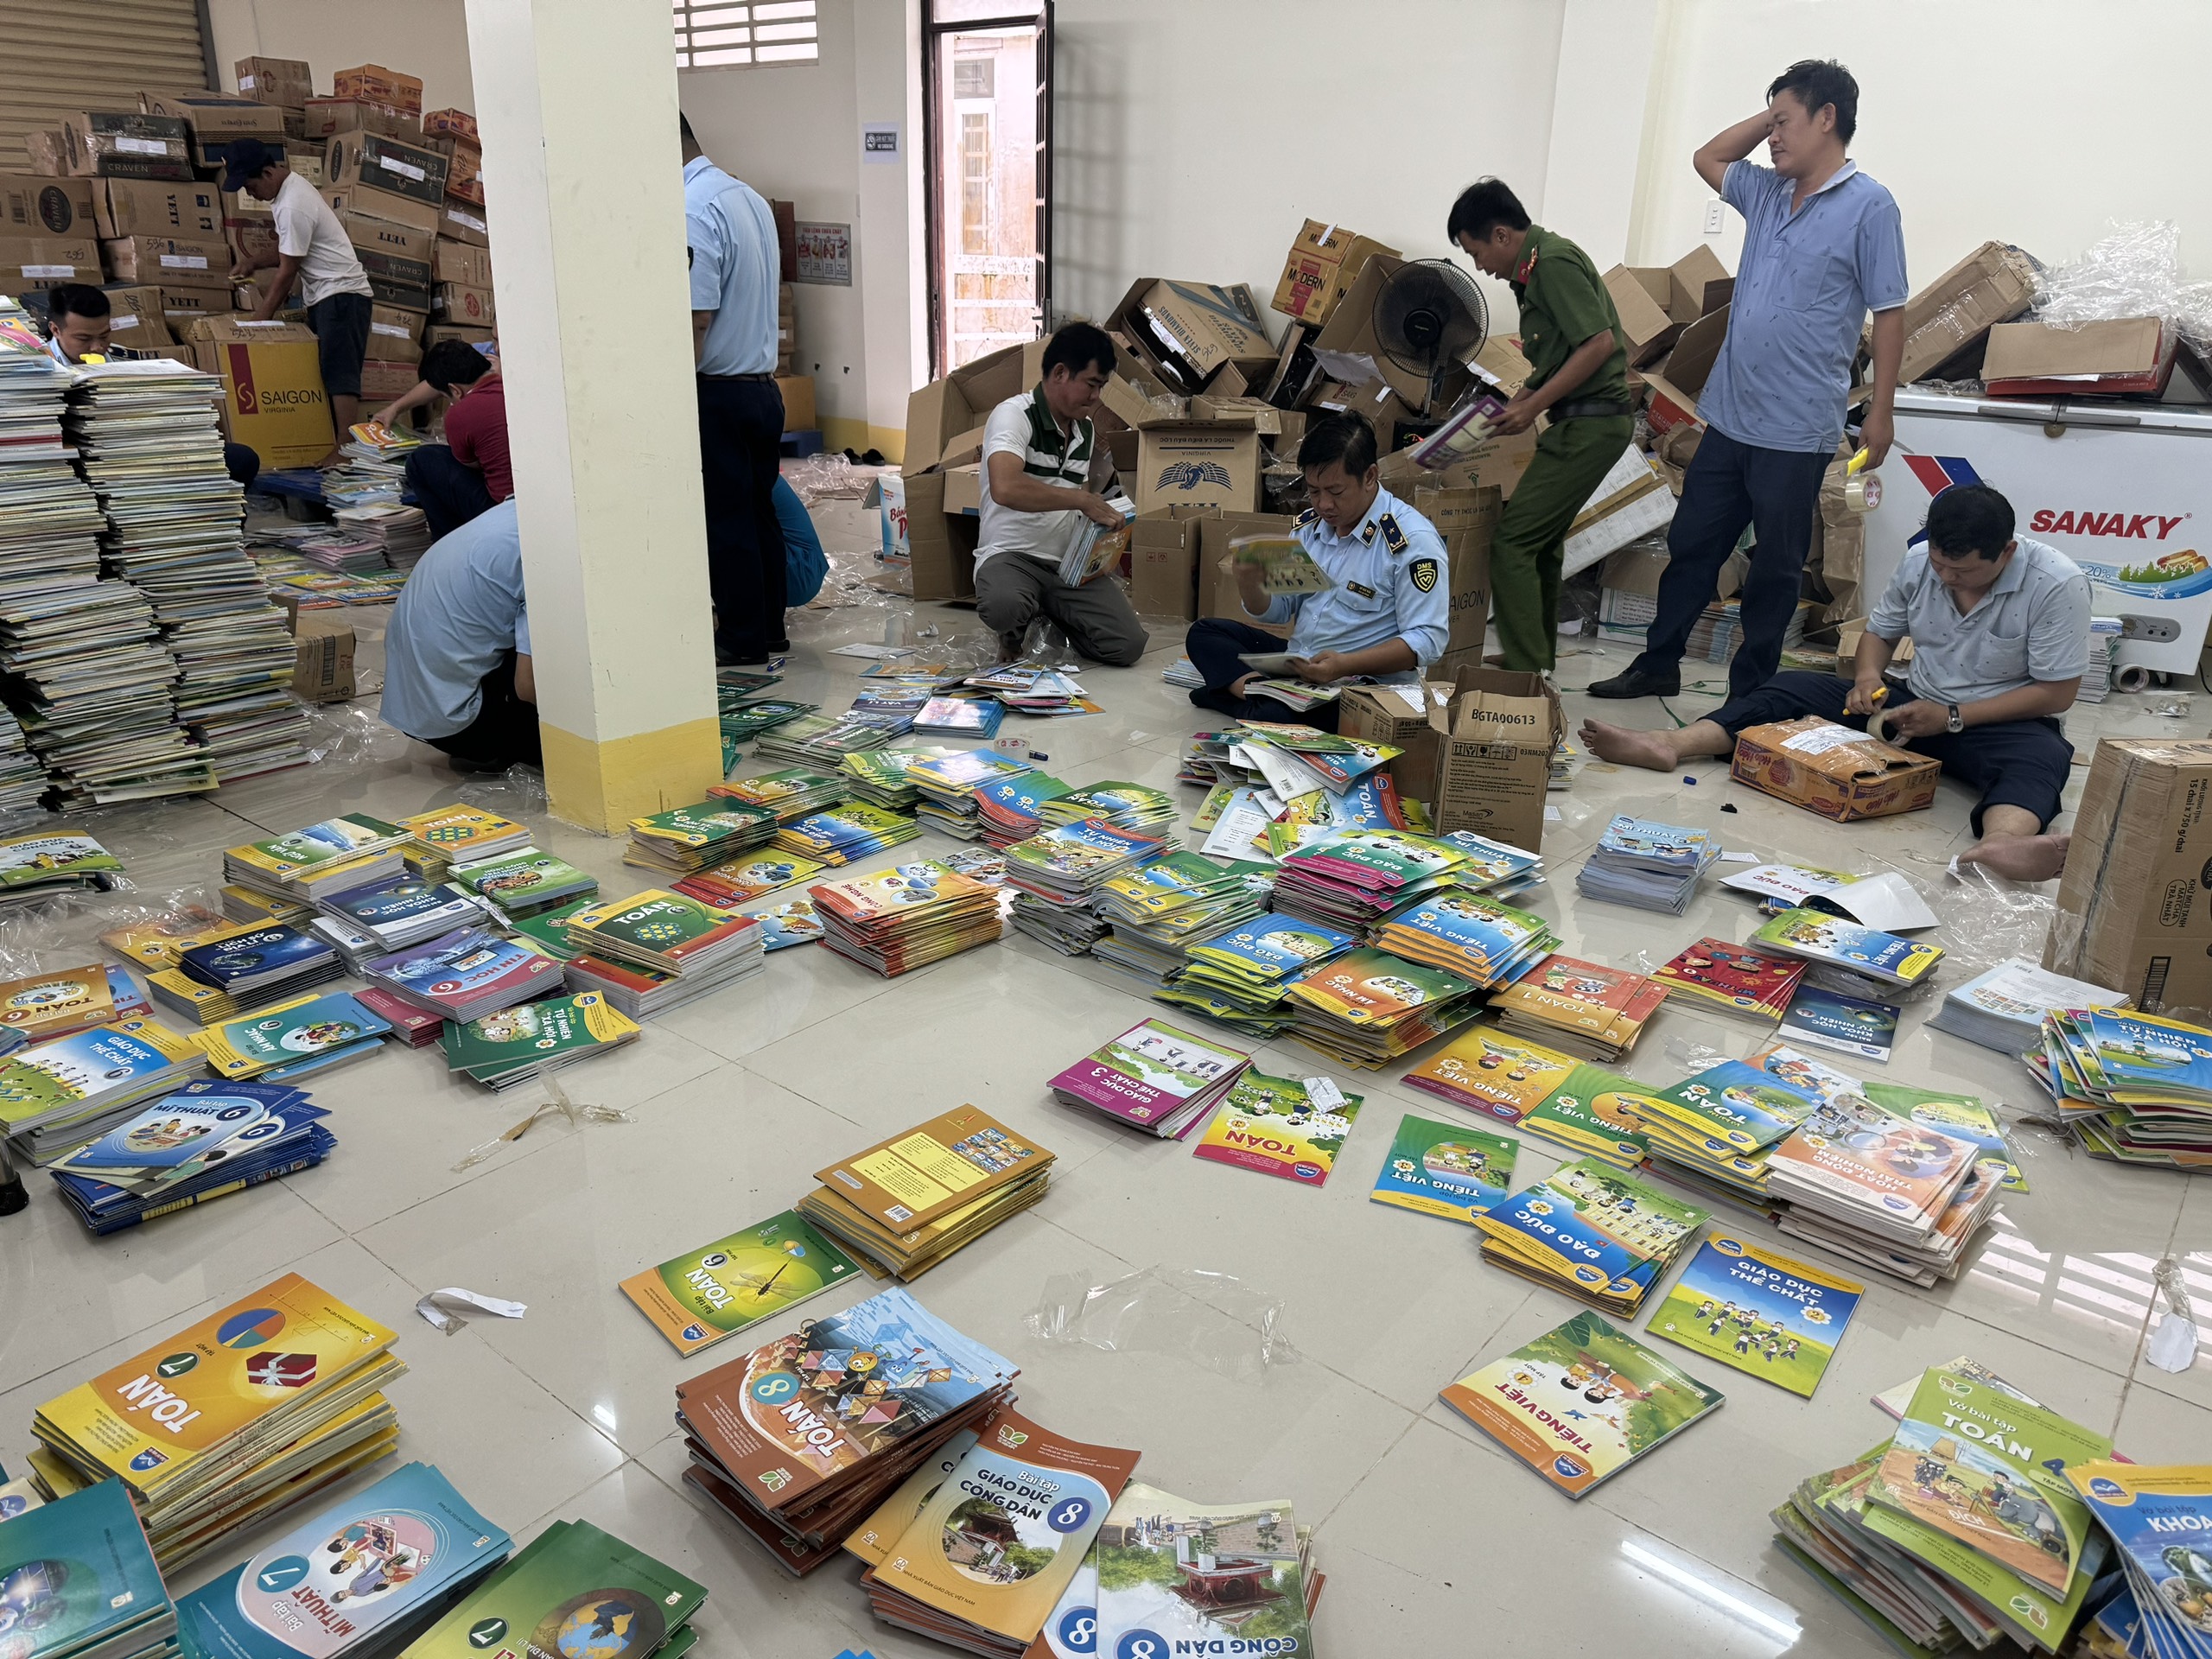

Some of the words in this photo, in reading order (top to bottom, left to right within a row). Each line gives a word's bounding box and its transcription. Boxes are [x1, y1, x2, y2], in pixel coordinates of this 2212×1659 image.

[108, 163, 149, 173] CRAVEN
[404, 155, 438, 171] CRAVEN
[48, 190, 60, 230] CRAVEN
[1308, 233, 1338, 249] MOERN
[391, 263, 423, 275] CRAVEN
[1287, 268, 1325, 291] MODERN
[1158, 306, 1185, 340] DIAMONDS
[1184, 334, 1201, 354] SEVEN
[261, 390, 321, 405] SAIGON
[2030, 509, 2184, 540] SANAKY
[1449, 589, 1484, 613] AIGON
[1471, 709, 1535, 725] BGTA00613
[2190, 779, 2198, 789] 15
[1357, 783, 1378, 819] TOÁN
[2186, 790, 2196, 807] chai
[424, 814, 470, 829] TOÁN
[2181, 814, 2190, 828] 750
[1099, 830, 1134, 847] NHIÊN
[2175, 829, 2186, 853] g/chai
[1341, 850, 1372, 862] ĐỨC
[1474, 845, 1514, 861] THUẬT
[1373, 859, 1402, 871] ĐẠO
[2167, 885, 2176, 899] TRÀ
[2187, 879, 2196, 894] KHỬ
[2162, 900, 2171, 921] NHẬT
[2171, 887, 2184, 918] MATCHA
[613, 900, 673, 925] TOÁN
[2178, 908, 2190, 928] TANH
[1410, 917, 1445, 939] VIỆT
[1225, 938, 1255, 951] ĐỨC
[1446, 931, 1490, 950] TIẾNG
[505, 952, 528, 967] TIN
[1254, 948, 1286, 962] ĐẠO
[464, 966, 502, 984] HỌC
[1324, 979, 1357, 999] NHẠC
[1356, 992, 1377, 1005] ÂM
[35, 996, 95, 1014] TOÁN
[1536, 995, 1586, 1014] TOÁN
[544, 1026, 558, 1039] HỘI
[556, 1017, 572, 1040] NHIÊN
[2119, 1022, 2139, 1034] TỰ
[2140, 1027, 2197, 1046] NHIÊN
[107, 1035, 131, 1052] GIÁO
[130, 1044, 153, 1060] DỤC
[2157, 1035, 2188, 1049] HỘI
[88, 1041, 107, 1057] THỂ
[105, 1049, 133, 1067] CHẤT
[1100, 1078, 1127, 1096] DỤC
[1432, 1067, 1471, 1090] VIỆT
[1127, 1090, 1154, 1104] GIÁO
[1135, 1086, 1161, 1099] THỂ
[1472, 1082, 1522, 1106] TIẾNG
[153, 1102, 175, 1114] MĨ
[173, 1104, 219, 1116] THUẬT
[1552, 1104, 1586, 1121] VIỆT
[1678, 1090, 1748, 1125] TOÁN
[1591, 1116, 1633, 1135] TIẾNG
[1224, 1130, 1297, 1157] TOÁN
[1391, 1171, 1427, 1187] VIỆT
[1432, 1179, 1480, 1198] TIẾNG
[1514, 1210, 1558, 1235] ĐỨC
[1557, 1234, 1603, 1260] ĐẠO
[684, 1268, 736, 1310] TOÁN
[1729, 1268, 1766, 1287] THỂ
[1768, 1284, 1820, 1306] CHẤT
[1738, 1261, 1783, 1282] GIÁO
[1784, 1279, 1824, 1298] DỤC
[1810, 1311, 1821, 1319] 2
[116, 1373, 202, 1434] TOÁN
[1495, 1382, 1535, 1413] VIỆT
[1948, 1398, 1967, 1410] Vở
[1968, 1408, 1991, 1421] bài
[1993, 1416, 2017, 1433] tập
[779, 1400, 847, 1458] TOÁN
[1535, 1408, 1592, 1455] TIẾNG
[1942, 1412, 2033, 1462] TOÁN
[977, 1469, 1017, 1491] GIÁO
[1017, 1485, 1052, 1504] DỤC
[1017, 1470, 1039, 1486] Bài
[1039, 1478, 1060, 1492] tập
[959, 1480, 1006, 1506] CÔNG
[1006, 1499, 1042, 1520] DÂN
[1058, 1503, 1083, 1524] 8
[2145, 1515, 2212, 1532] KHOA
[270, 1599, 289, 1617] tập
[291, 1584, 341, 1626] THUẬT
[287, 1614, 304, 1632] Bài
[1175, 1637, 1224, 1655] DÂN
[1233, 1635, 1299, 1654] CÔNG
